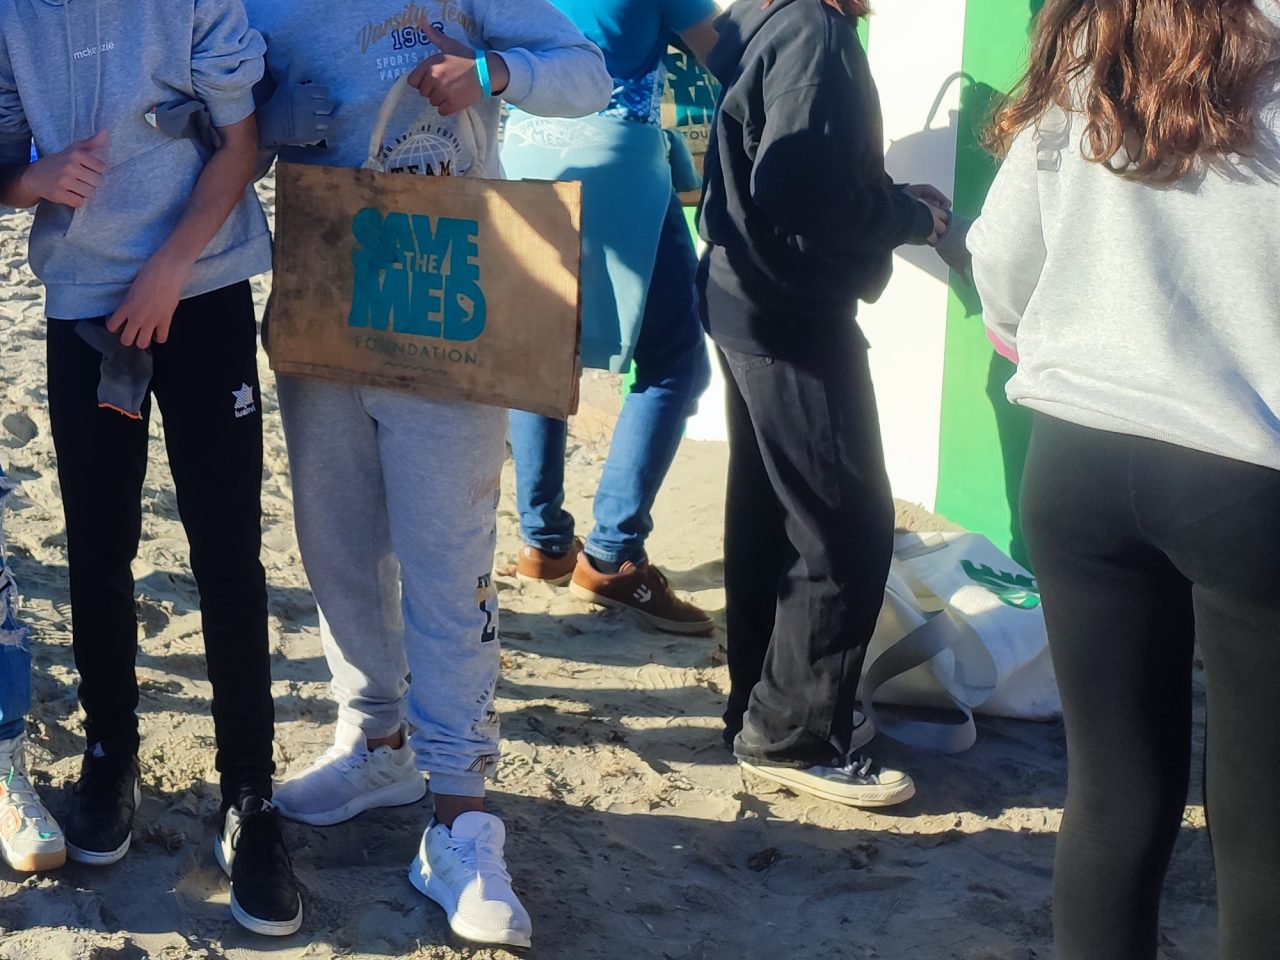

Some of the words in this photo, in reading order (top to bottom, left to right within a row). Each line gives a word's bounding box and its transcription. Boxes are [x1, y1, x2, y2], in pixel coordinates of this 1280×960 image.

[73, 41, 115, 60] mckezie
[376, 52, 418, 70] SPORTS
[351, 207, 481, 281] SAVE
[403, 250, 439, 275] THE
[348, 265, 488, 343] MED
[354, 336, 479, 366] FOUNDATION
